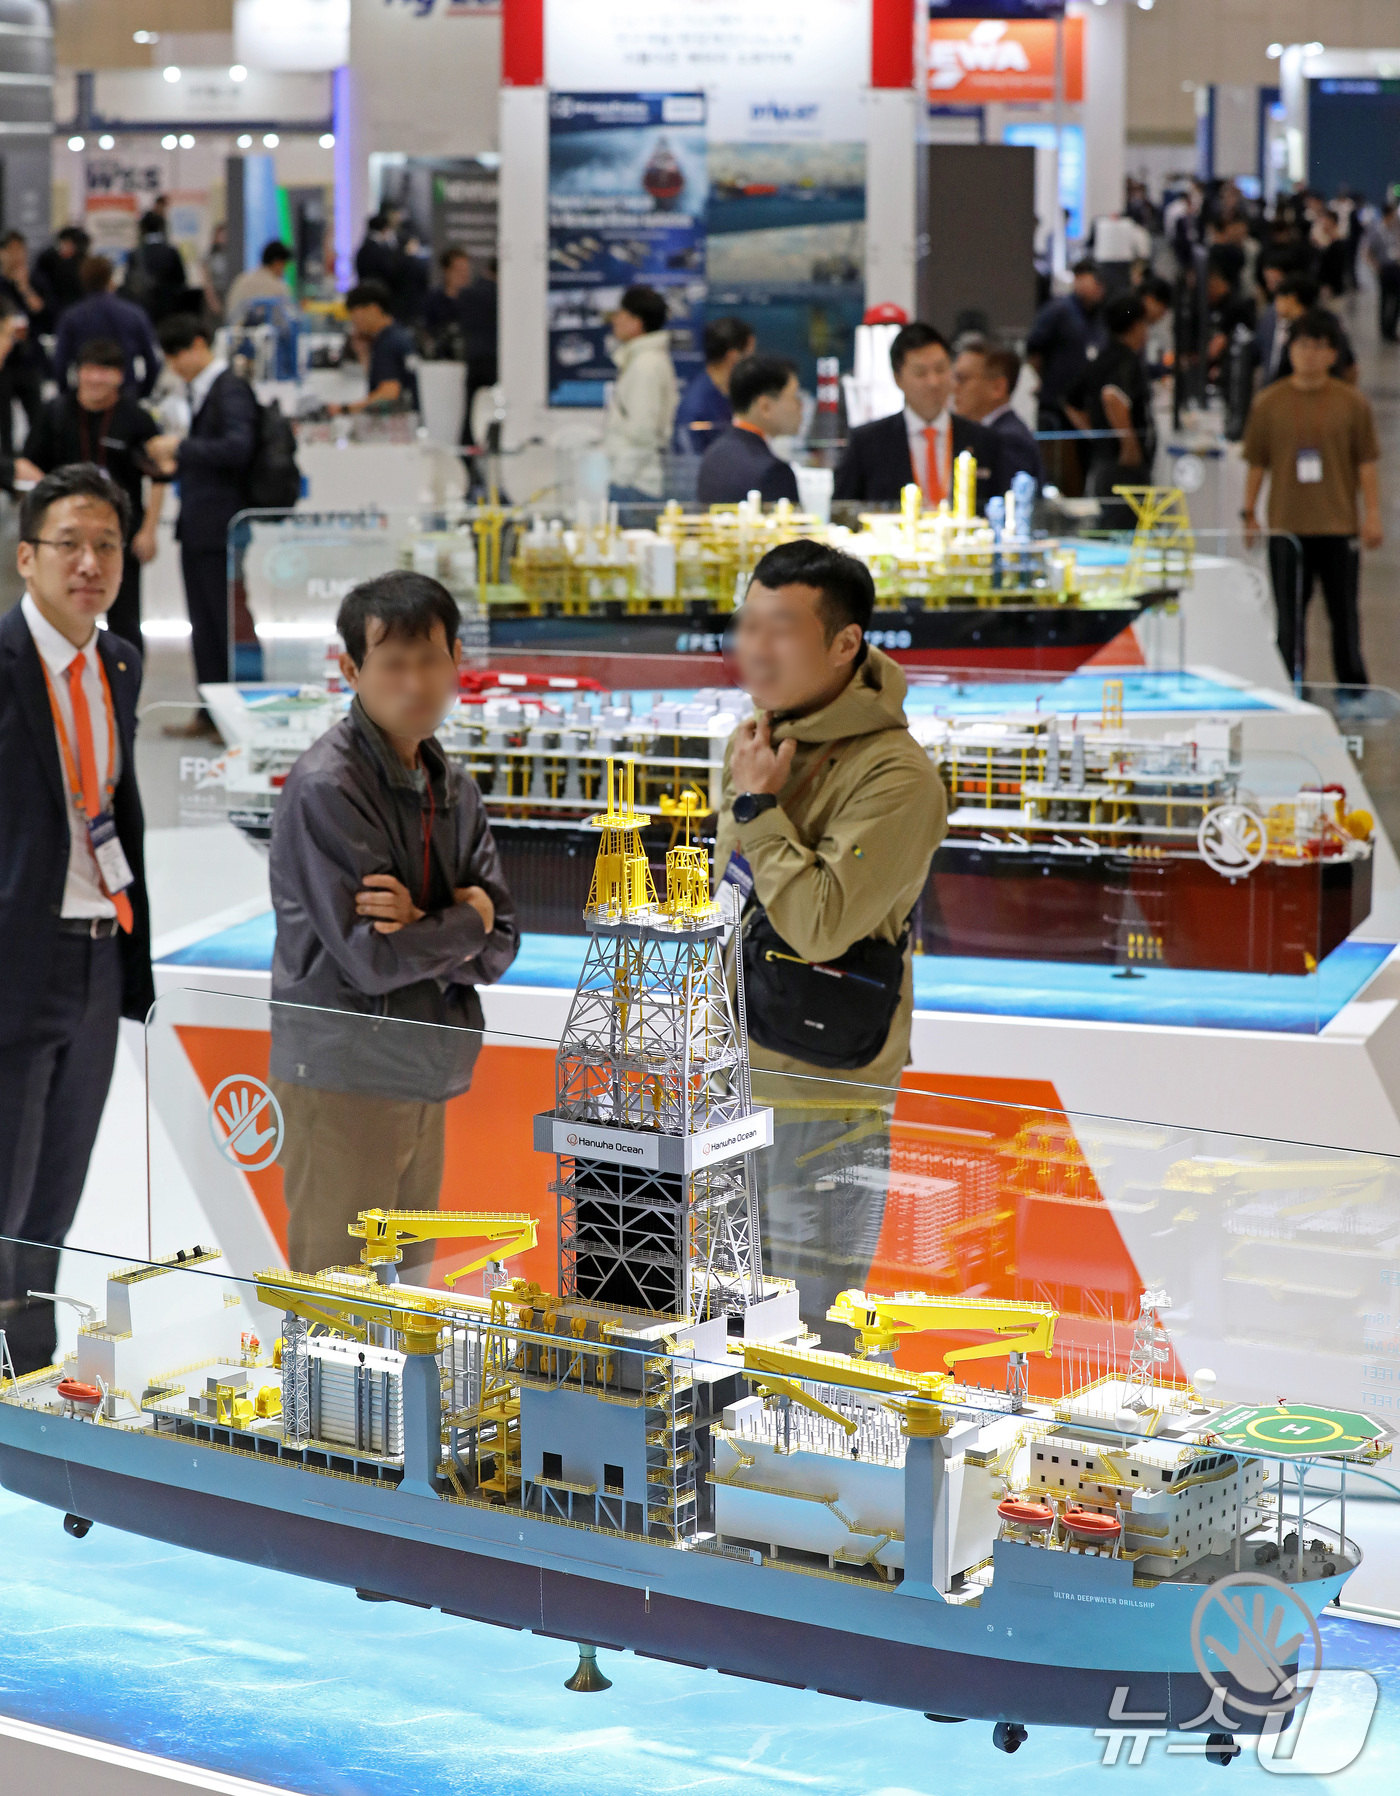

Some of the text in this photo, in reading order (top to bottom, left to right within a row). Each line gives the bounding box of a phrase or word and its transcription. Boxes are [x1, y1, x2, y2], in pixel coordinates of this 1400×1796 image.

[578, 1136, 644, 1155] Hanwha Ocean
[711, 1129, 757, 1152] Hanwha Ocean
[1053, 1591, 1155, 1608] ULTRA DEEPWATER DRILLSHIP
